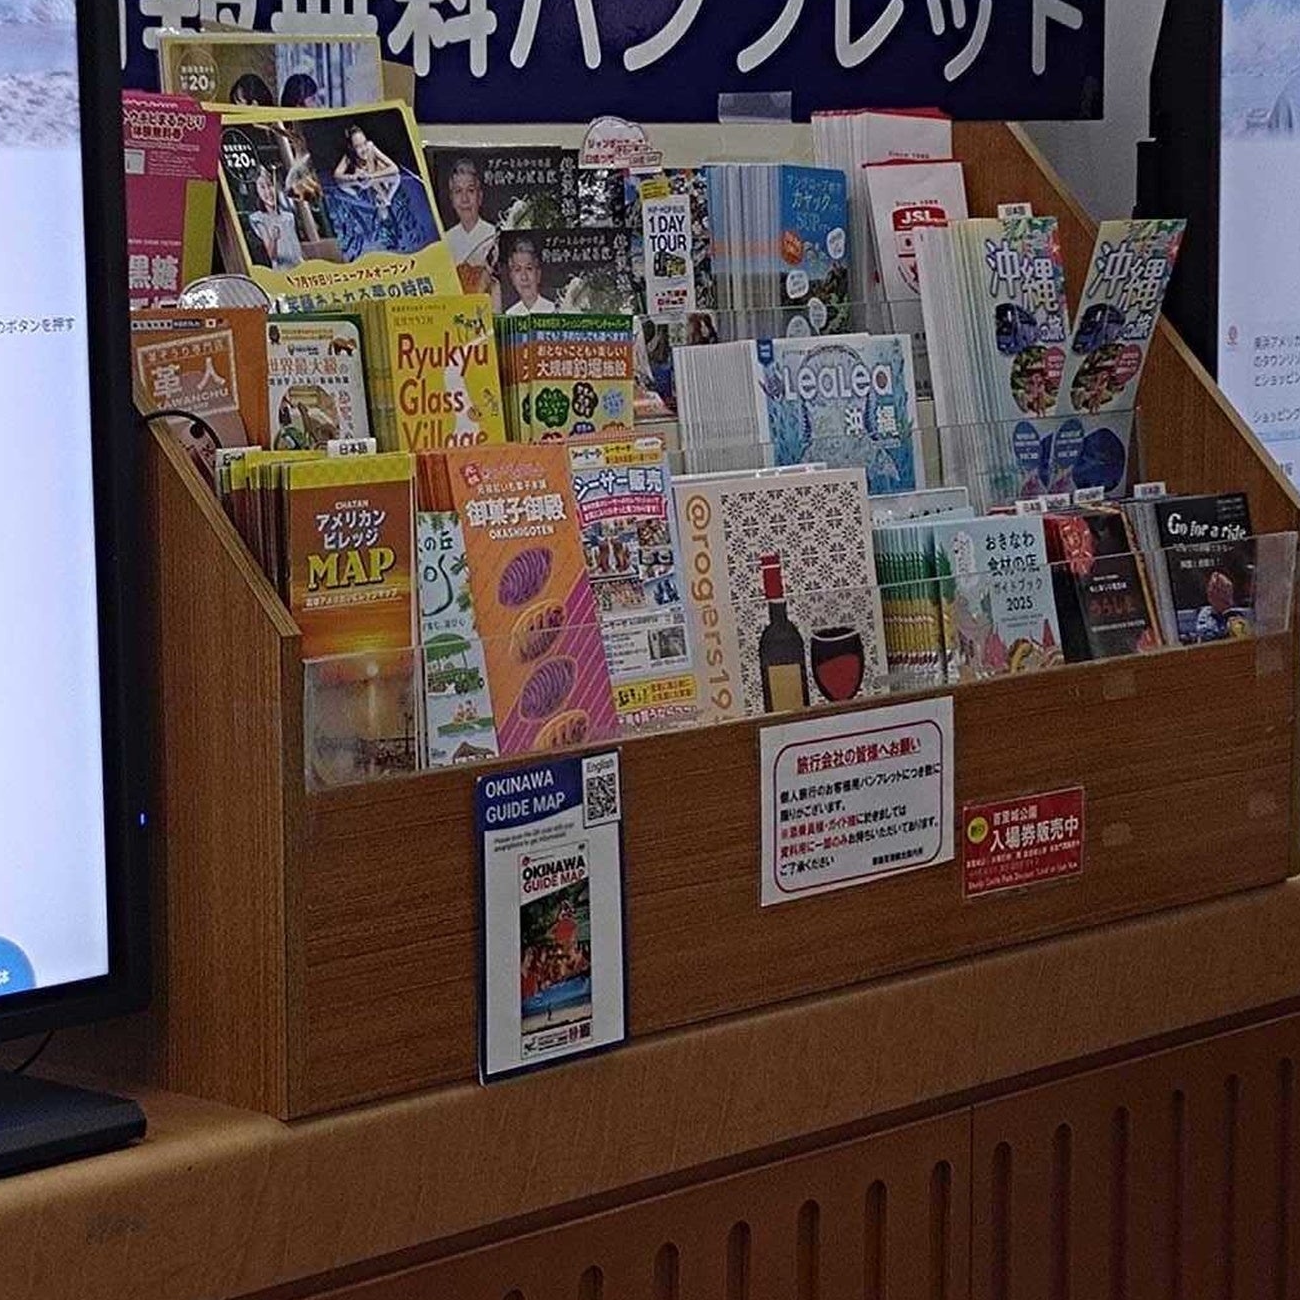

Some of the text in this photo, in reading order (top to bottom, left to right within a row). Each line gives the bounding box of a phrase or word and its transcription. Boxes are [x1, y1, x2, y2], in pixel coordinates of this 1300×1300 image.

[650, 215, 685, 233] 1 DAY
[650, 233, 687, 251] TOUR
[128, 254, 179, 290] 黒糖
[985, 239, 1060, 313] 沖縄
[1088, 240, 1167, 312] 沖縄
[397, 331, 488, 378] Ryukyu
[399, 379, 465, 416] Glass
[339, 441, 369, 456] 日本語
[400, 420, 488, 450] Village
[574, 468, 664, 500] シーサー販売
[335, 499, 369, 510] CHATAN
[466, 493, 566, 528] 御菓子御殿
[316, 509, 386, 531] アメリカン
[489, 525, 554, 540] OKASHIGOTEN
[1167, 513, 1188, 536] Go
[1190, 520, 1208, 538] for
[1221, 522, 1247, 541] ride
[324, 529, 379, 550] ビレッジ
[985, 532, 1035, 550] おきなわ
[307, 548, 395, 591] MAP
[1006, 596, 1033, 612] 2025
[586, 758, 614, 773] English
[797, 736, 921, 776] 旅行会社の皆様へお願い
[485, 769, 554, 799] OKINAWA
[485, 791, 566, 823] GUIDE MAP
[990, 814, 1079, 852] 入場券販売中
[522, 855, 585, 881] OKINAWA
[523, 869, 585, 893] GUIDE MAP
